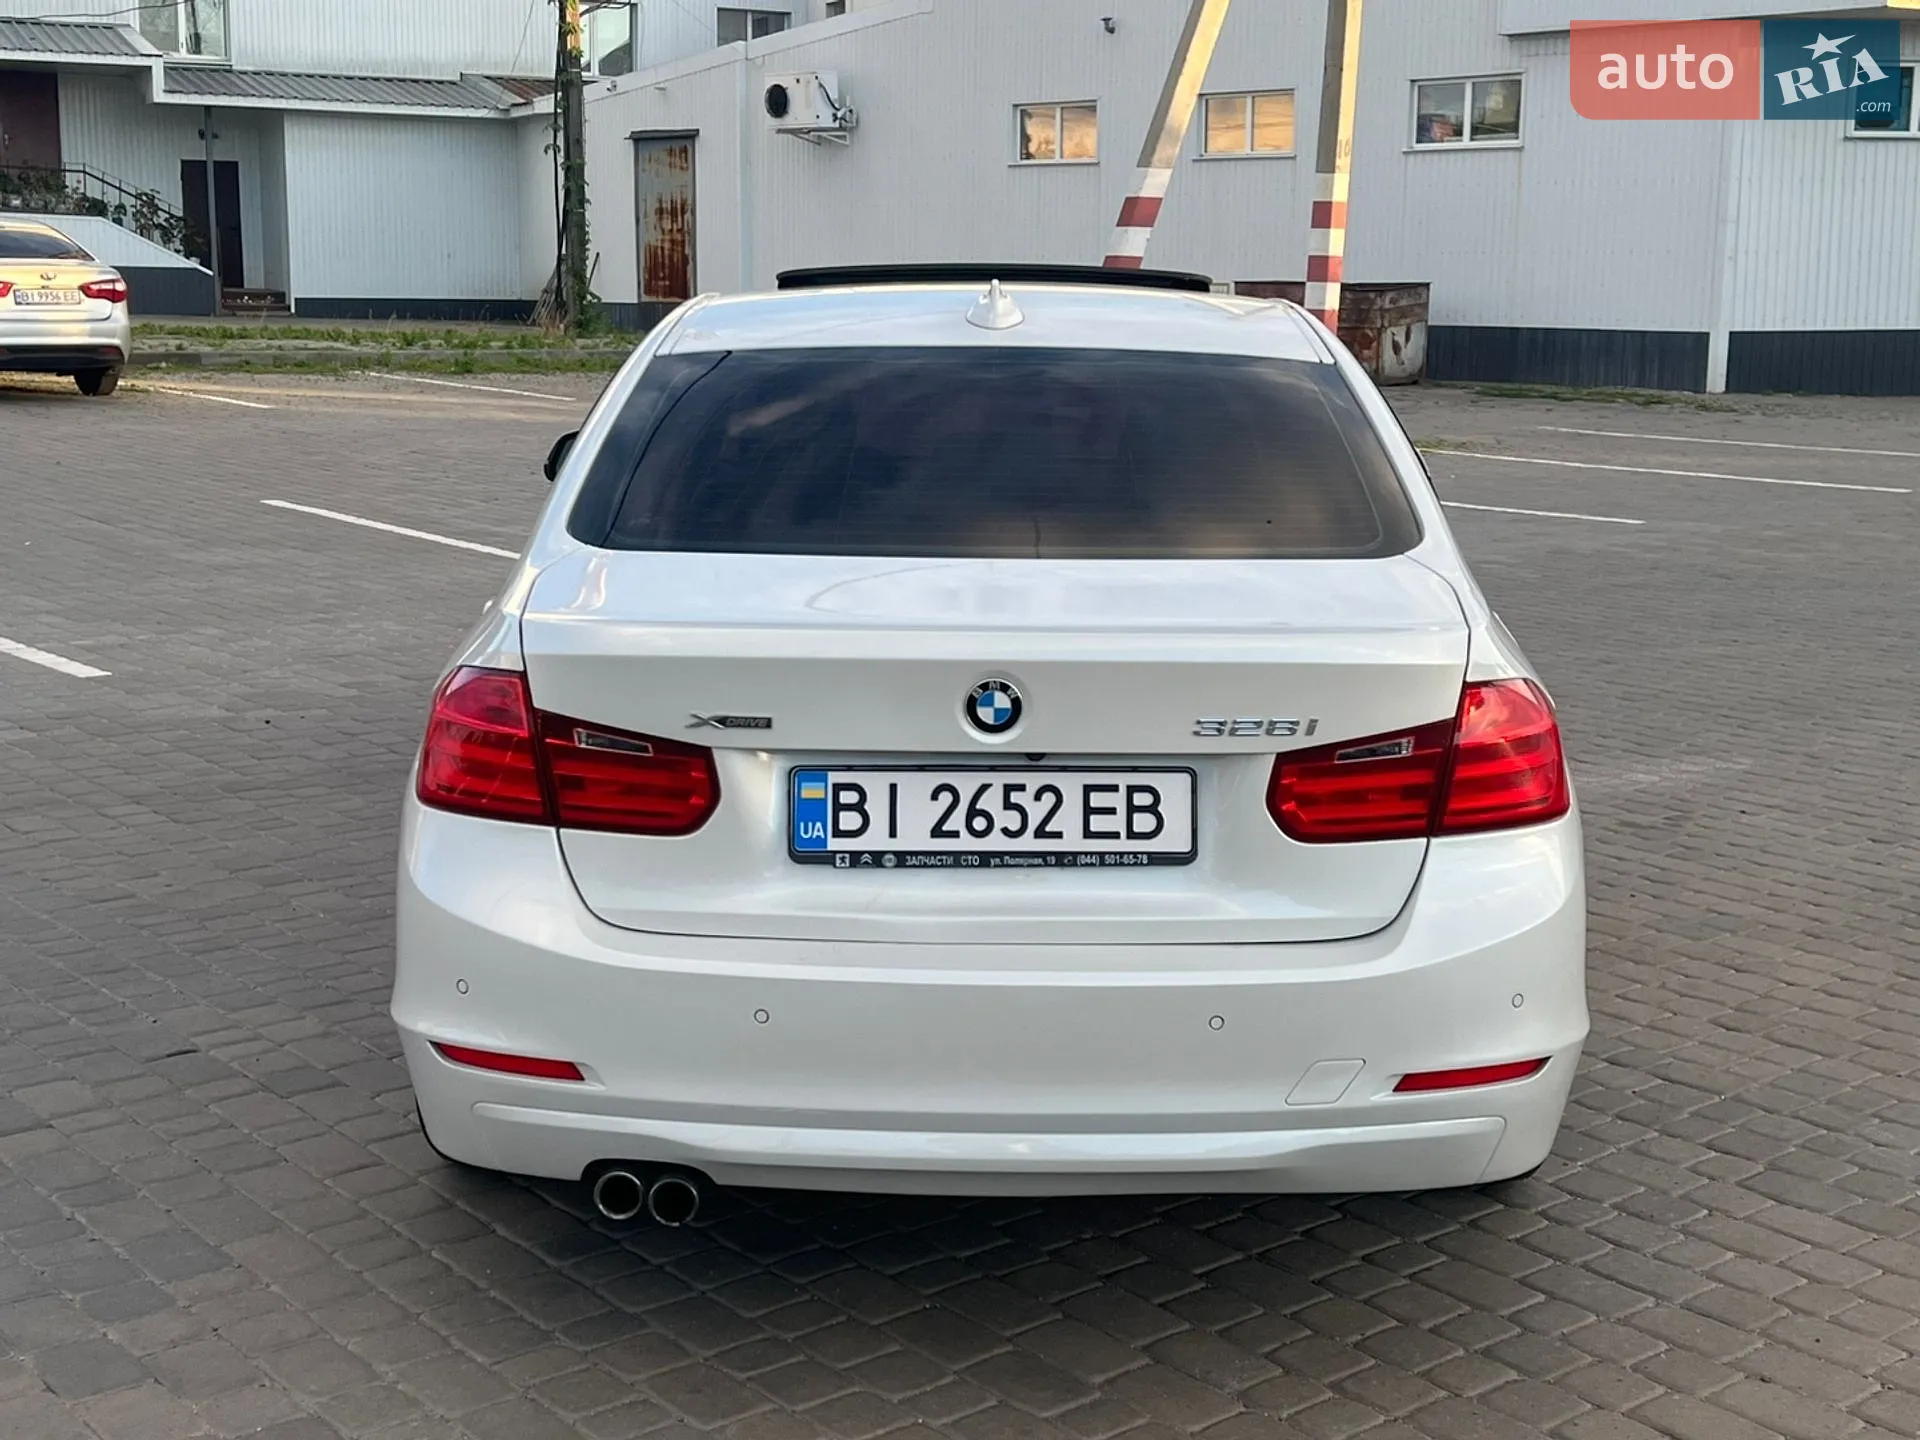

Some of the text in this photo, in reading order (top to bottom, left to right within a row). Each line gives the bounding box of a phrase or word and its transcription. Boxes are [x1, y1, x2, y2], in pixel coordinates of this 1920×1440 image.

[1192, 717, 1319, 737] 328i
[832, 782, 1165, 840] BI 2652 EB
[800, 821, 825, 839] UA
[905, 855, 954, 866] ЗАПЧАСТИ
[960, 855, 980, 866] СТО
[1077, 854, 1100, 867] (044)
[1104, 854, 1149, 865] 501-65-78
